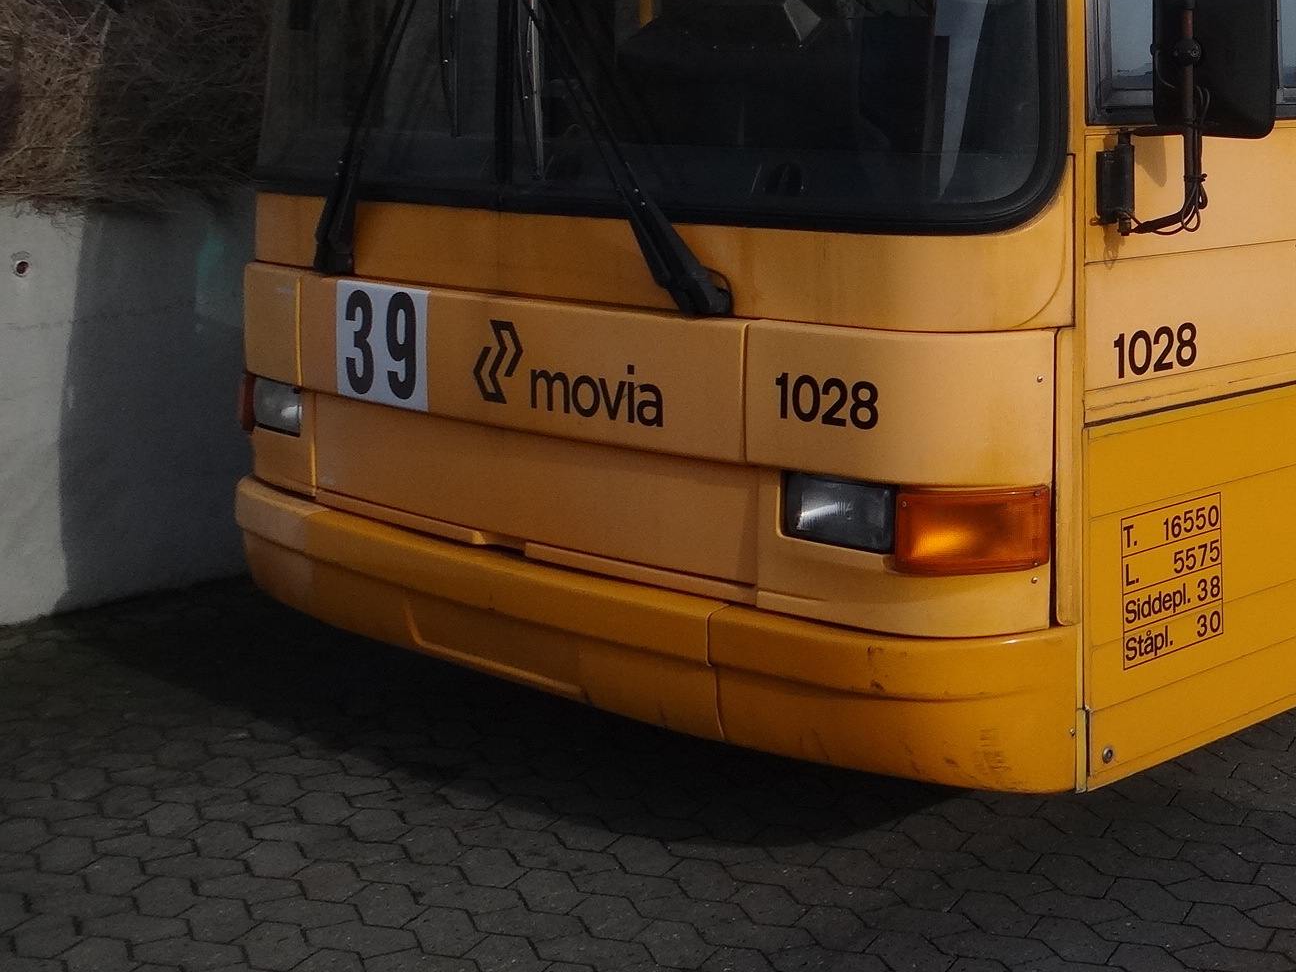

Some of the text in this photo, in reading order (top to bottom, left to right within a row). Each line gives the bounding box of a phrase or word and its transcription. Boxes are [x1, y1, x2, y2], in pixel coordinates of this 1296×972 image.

[344, 289, 418, 401] 39
[1112, 322, 1198, 379] 1028
[529, 364, 665, 428] movia
[774, 372, 880, 430] 1028
[1123, 504, 1220, 549] T. 16550
[1125, 539, 1221, 587] L. 5575
[1125, 575, 1221, 625] Siddepl. 38
[1125, 611, 1222, 662] Ståpl. 30
